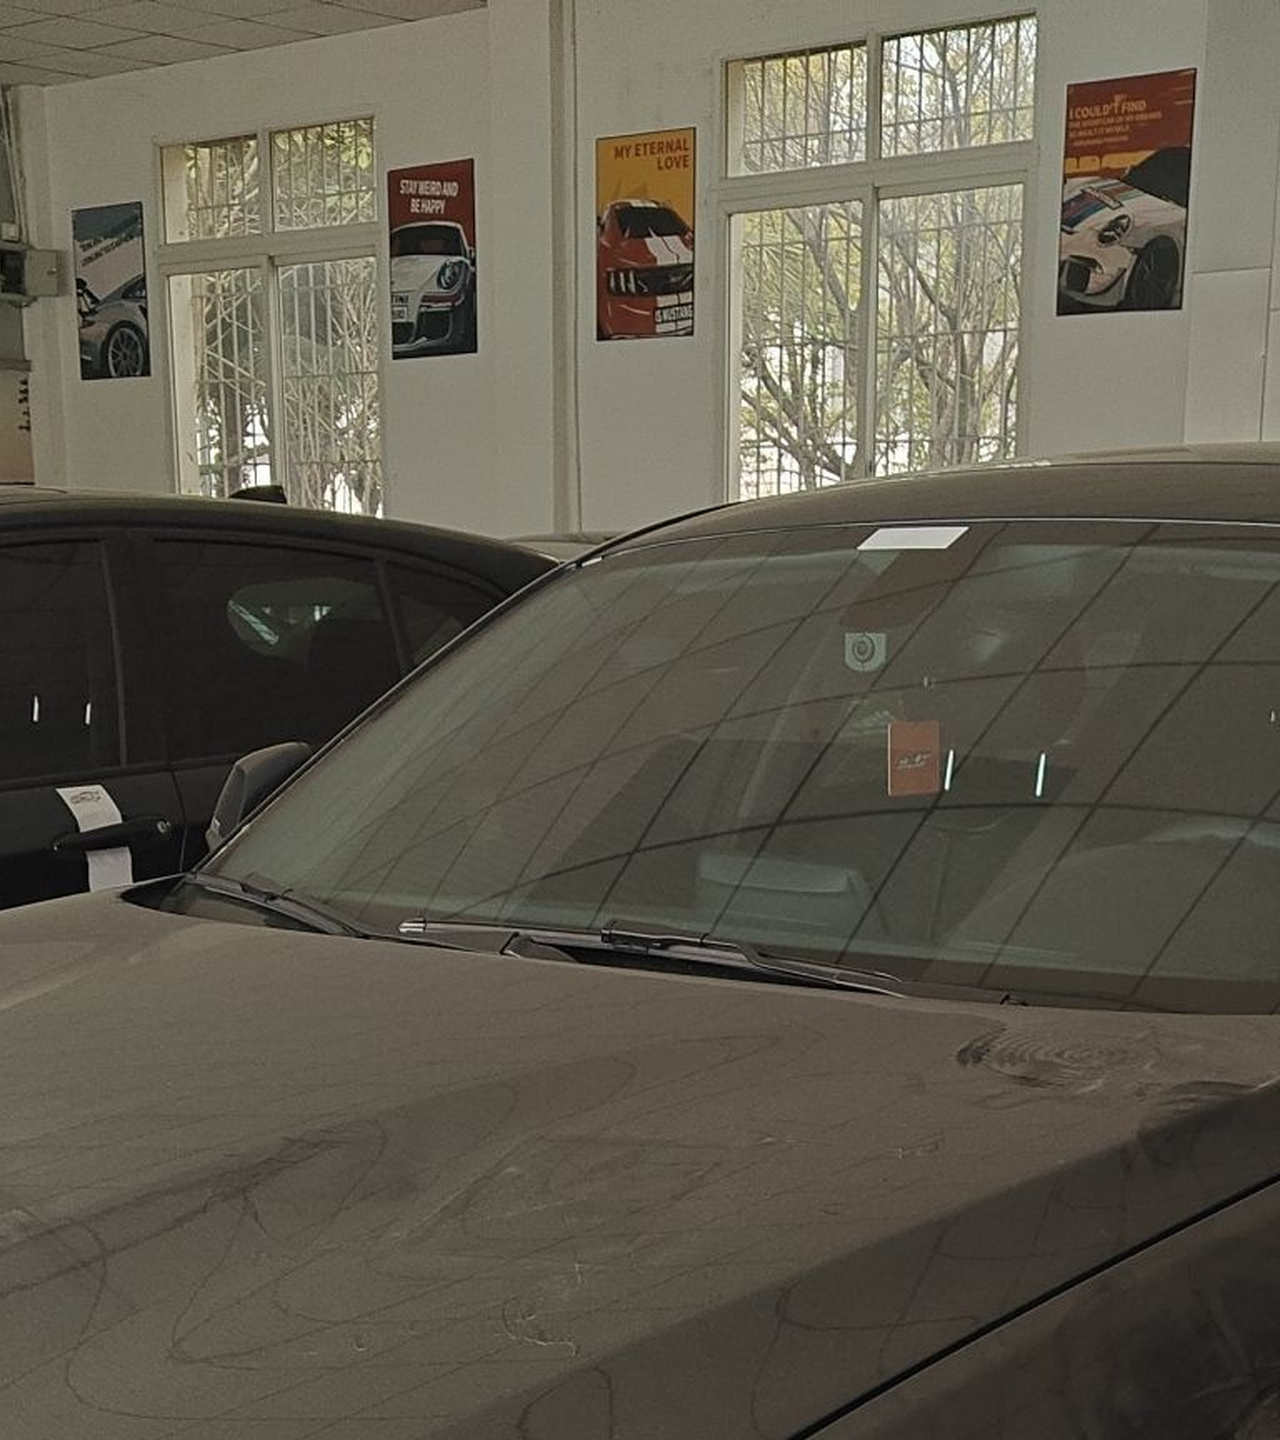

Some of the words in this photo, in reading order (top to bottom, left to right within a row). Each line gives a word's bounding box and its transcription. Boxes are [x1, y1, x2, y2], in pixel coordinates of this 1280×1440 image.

[1121, 100, 1147, 115] FIND
[614, 145, 632, 160] MY
[634, 138, 689, 157] ETERNAL
[657, 155, 689, 171] LOVE
[400, 179, 418, 195] STAY
[442, 181, 459, 197] AND
[410, 198, 420, 213] BE
[421, 199, 446, 214] HAPPY
